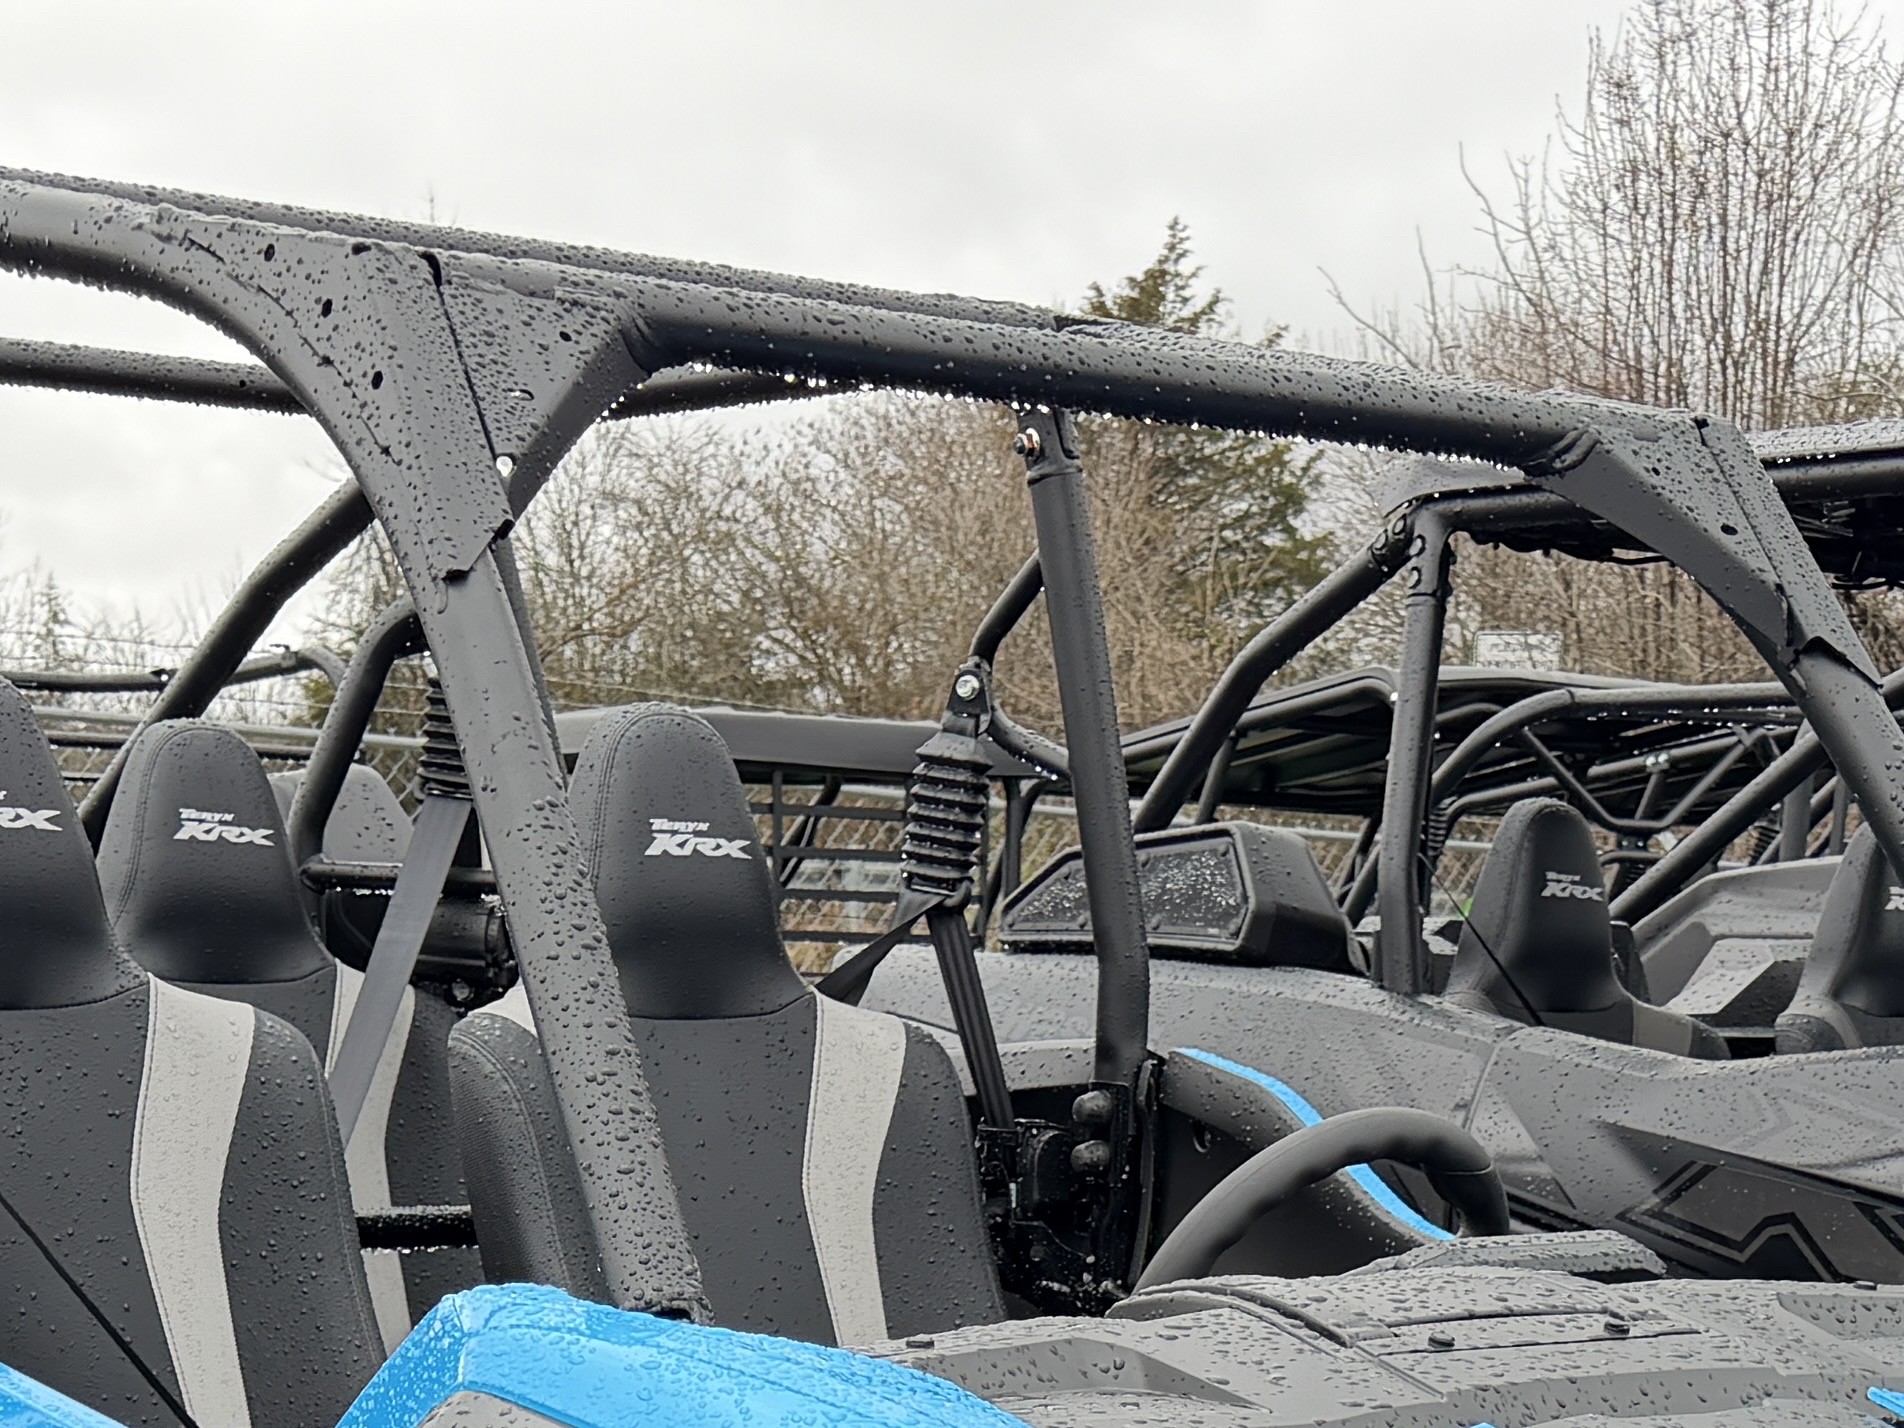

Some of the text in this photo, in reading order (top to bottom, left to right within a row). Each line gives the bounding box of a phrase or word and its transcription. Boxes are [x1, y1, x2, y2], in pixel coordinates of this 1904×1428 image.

[173, 821, 275, 846] KRX
[644, 833, 752, 859] KRX
[1540, 881, 1604, 901] KRX
